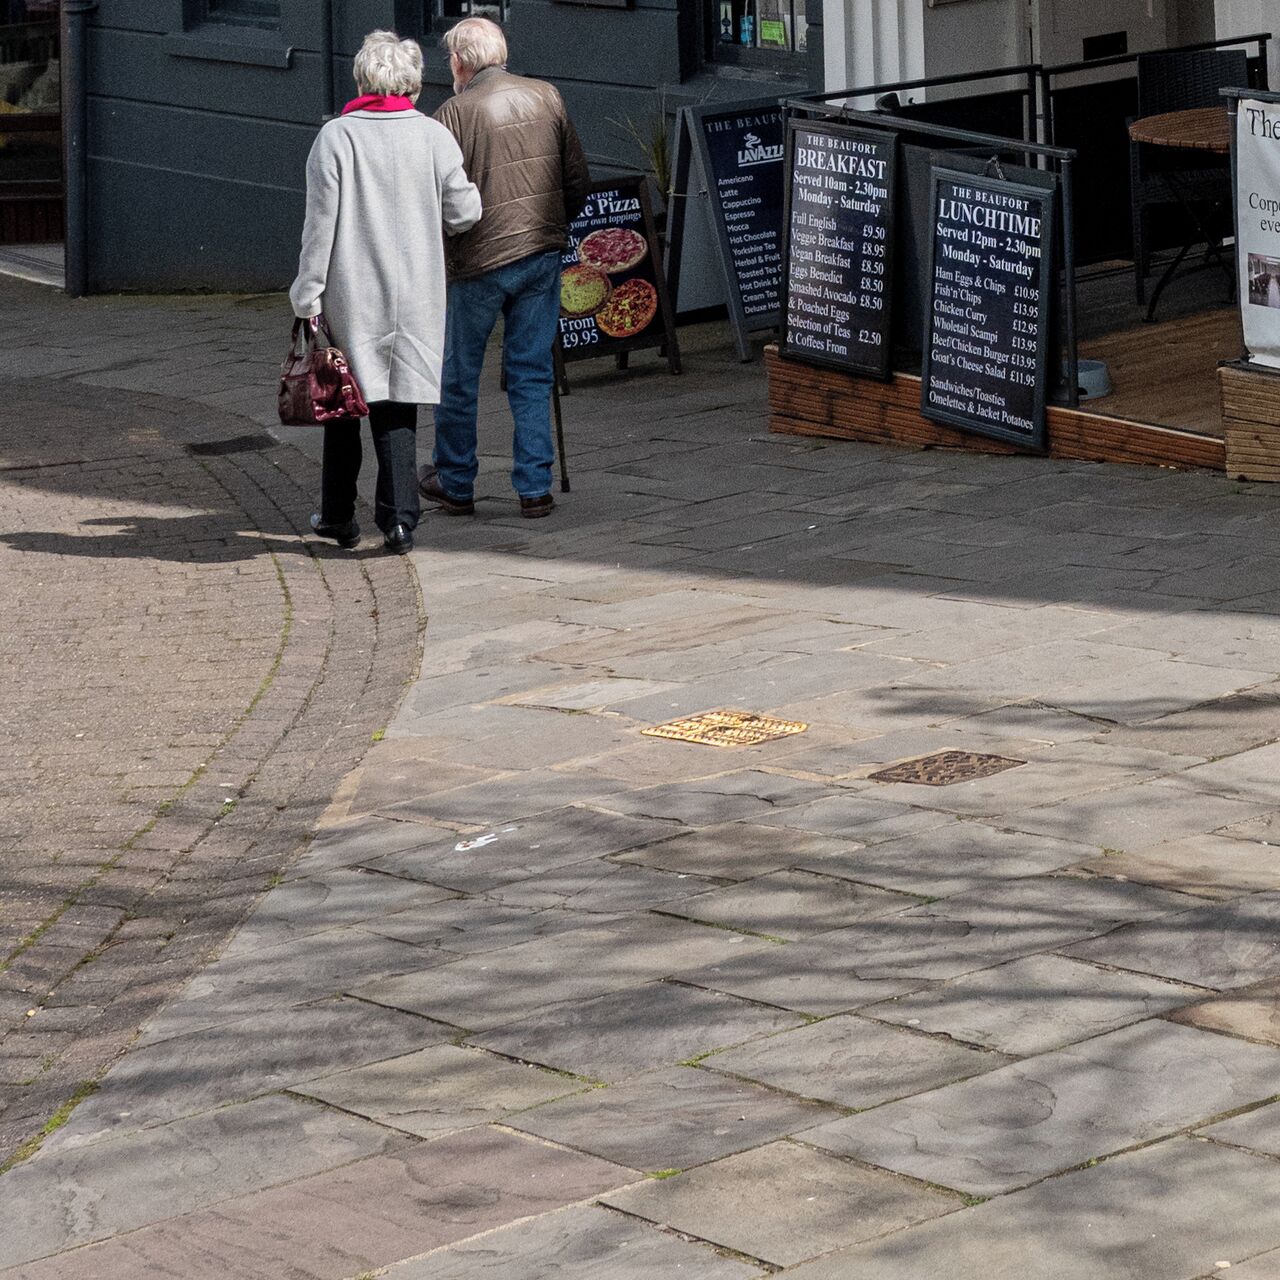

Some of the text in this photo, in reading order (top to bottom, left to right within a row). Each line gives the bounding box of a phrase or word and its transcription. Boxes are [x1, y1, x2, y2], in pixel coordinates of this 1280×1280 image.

[705, 120, 732, 133] THE
[806, 134, 878, 155] THE BEAUFORT
[797, 147, 887, 179] BREAKFAST
[718, 174, 754, 186] Americano
[719, 188, 739, 199] Latte
[793, 170, 888, 200] Served 10am 2.30pm
[598, 196, 641, 216] Pizza
[722, 196, 762, 210] Cappuccino
[797, 187, 881, 217] Monday Saturday
[952, 185, 1029, 211] THE BEAUFORT
[591, 217, 607, 227] own
[608, 210, 642, 225] toppings
[724, 209, 756, 222] Espresso
[792, 210, 886, 240] Full English £9.50
[939, 198, 1041, 238] LUNCHTIME
[729, 230, 777, 245] Hot Chocolate
[732, 244, 763, 256] Yorkshire
[791, 228, 886, 258] Veggie Breakfast £8.95
[936, 222, 1041, 259] Served 12pm 2.30pm
[735, 256, 757, 268] Herbal
[790, 244, 884, 276] Vegan Breakfast £8.50
[942, 243, 1034, 280] Monday Saturday
[789, 262, 808, 280] Eggs
[810, 266, 843, 285] Benedict
[860, 276, 884, 293] £8.50
[935, 266, 1040, 301] Ham Eggs & Chips £10.95
[742, 292, 765, 303] Cream
[789, 279, 883, 310] Smashed Avocado £8.50
[559, 316, 596, 333] From
[787, 296, 850, 324] & Poached Eggs
[933, 299, 1038, 336] Chicken Curry £12.95
[1013, 301, 1039, 319] £13.95
[562, 329, 599, 348] £9.95
[786, 331, 848, 356] & Coffees From
[787, 313, 882, 346] Selection of Teas £2.50
[933, 315, 1037, 353] Wholetail Scampi £13.95
[932, 332, 1036, 370] Beef/Chicken Burger £13.95
[931, 349, 1035, 388] Goat's Cheese Salad £11.95
[930, 375, 1006, 407] Sandwiches/Toasties
[929, 390, 1034, 431] Omelettes & Jacket Potatoes
